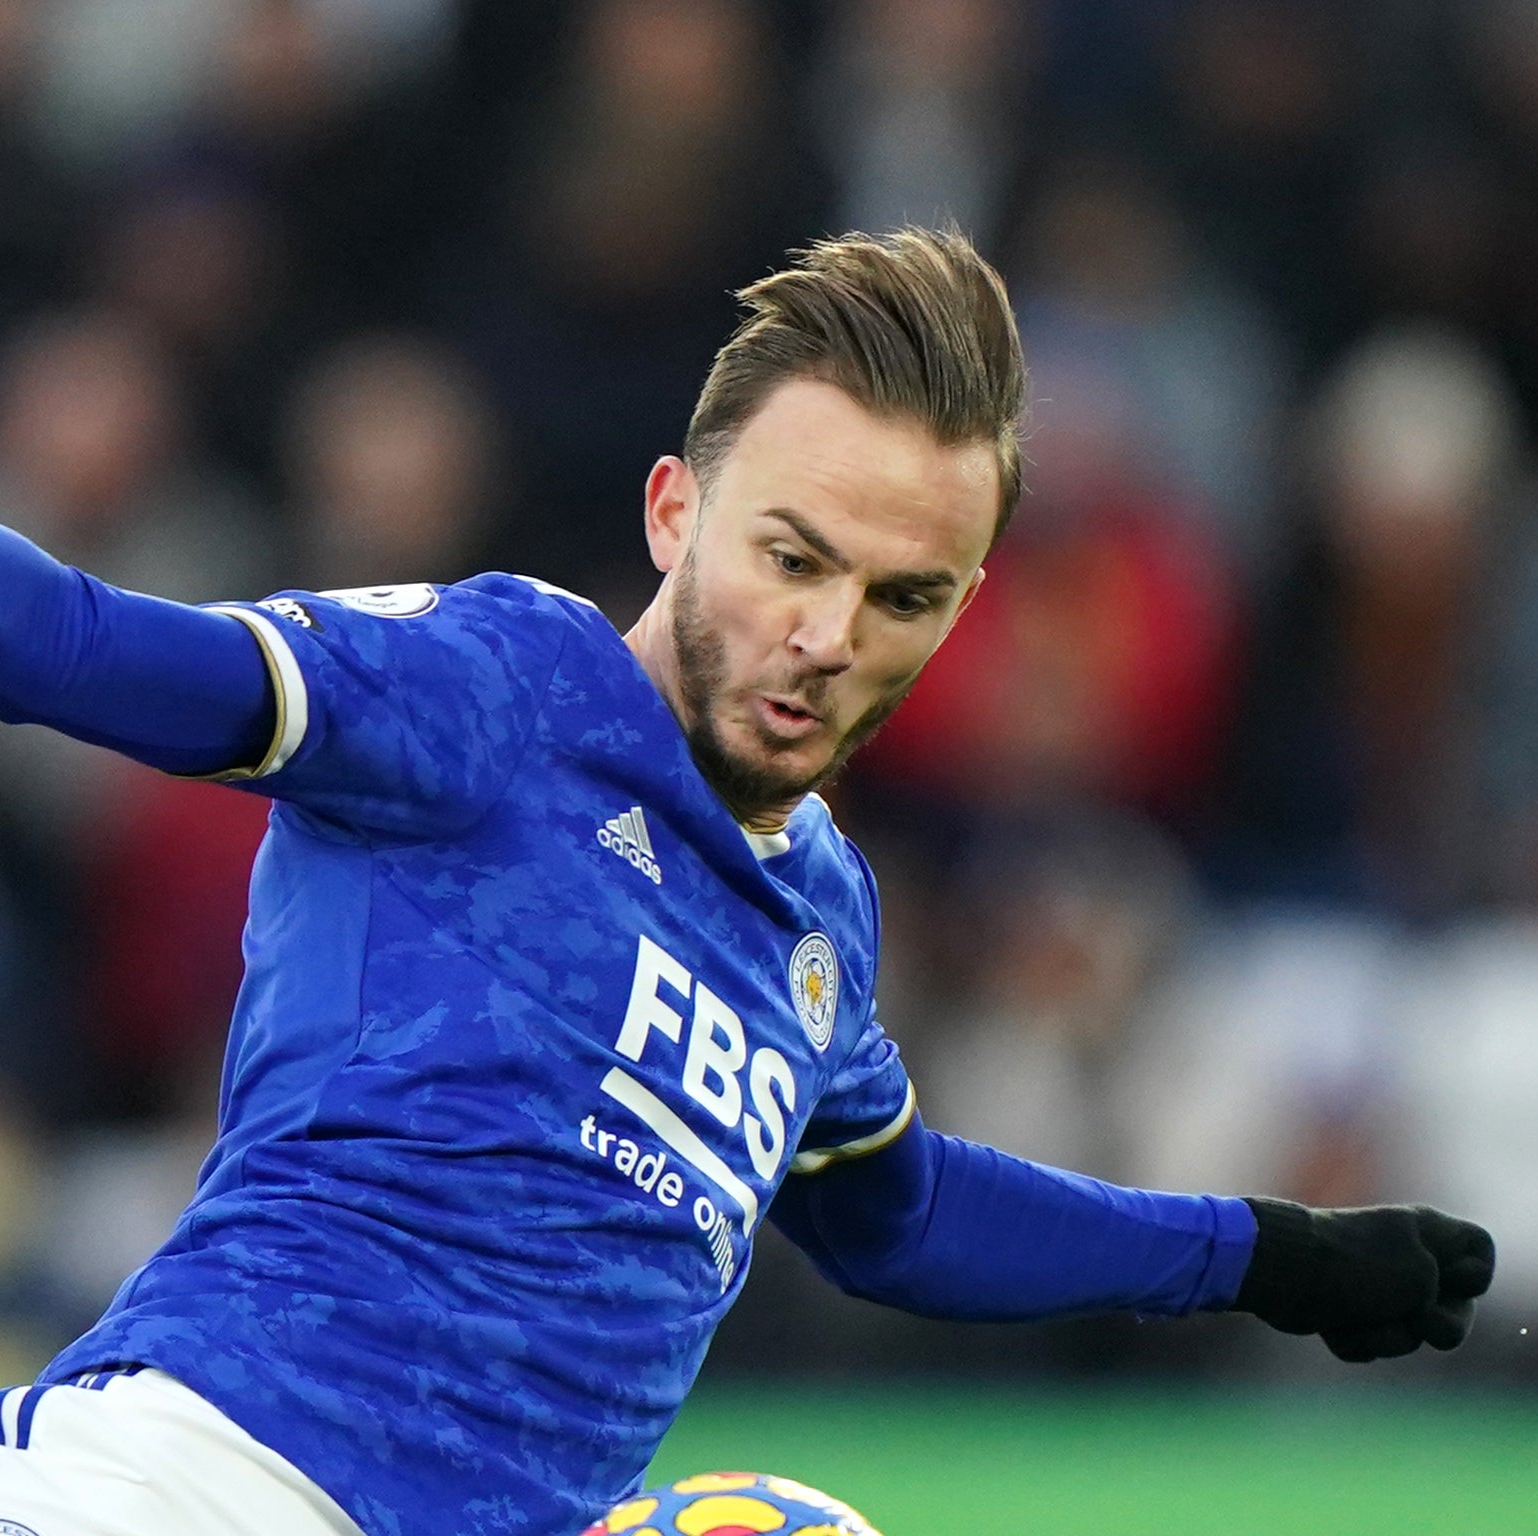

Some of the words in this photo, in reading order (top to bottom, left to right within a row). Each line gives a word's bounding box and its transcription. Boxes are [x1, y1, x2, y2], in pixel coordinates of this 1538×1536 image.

[597, 829, 661, 885] adidas
[614, 934, 796, 1181] FBS
[580, 1114, 684, 1208] trade
[693, 1196, 735, 1295] online
